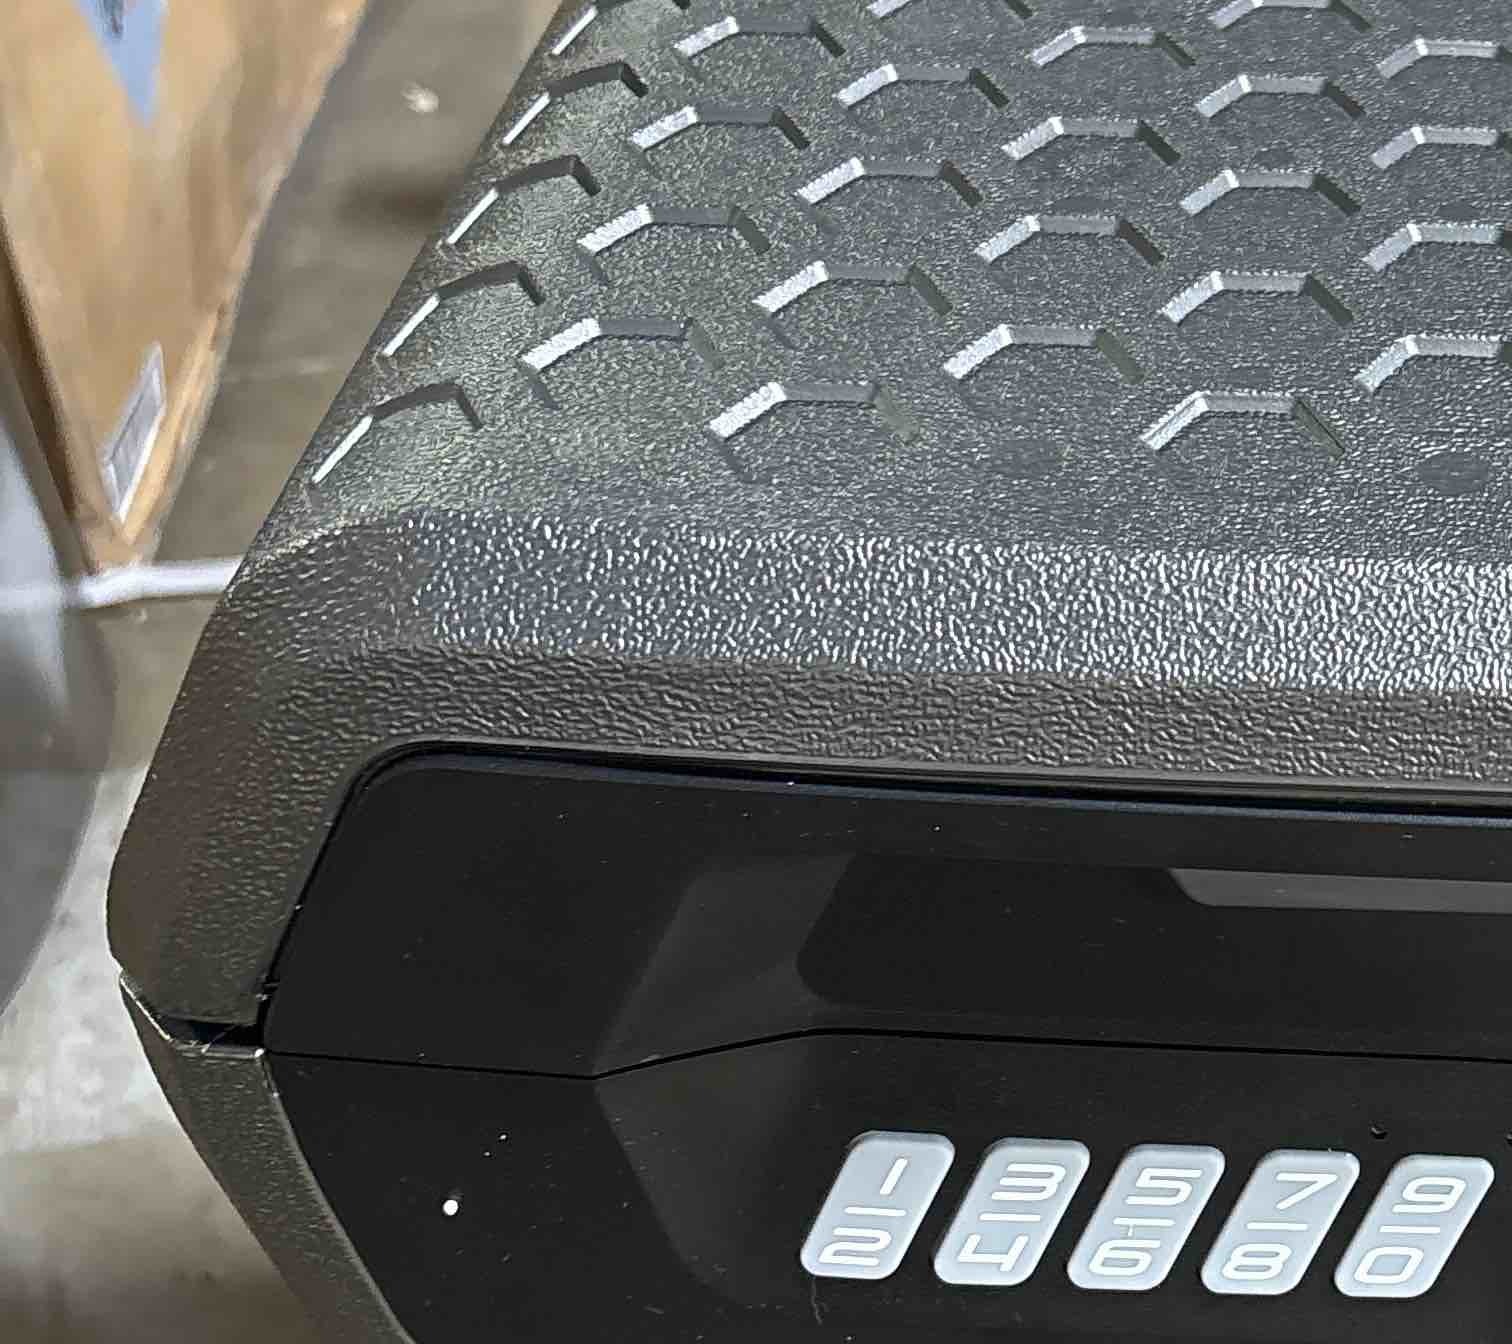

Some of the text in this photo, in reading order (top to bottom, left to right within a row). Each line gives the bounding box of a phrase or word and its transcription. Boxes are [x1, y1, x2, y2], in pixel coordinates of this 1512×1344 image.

[879, 1158, 1467, 1214] 1 3 5 7 9
[817, 1226, 892, 1267] 2
[955, 1234, 1028, 1273] 4
[1088, 1239, 1162, 1276] 6
[1220, 1243, 1294, 1281] 8
